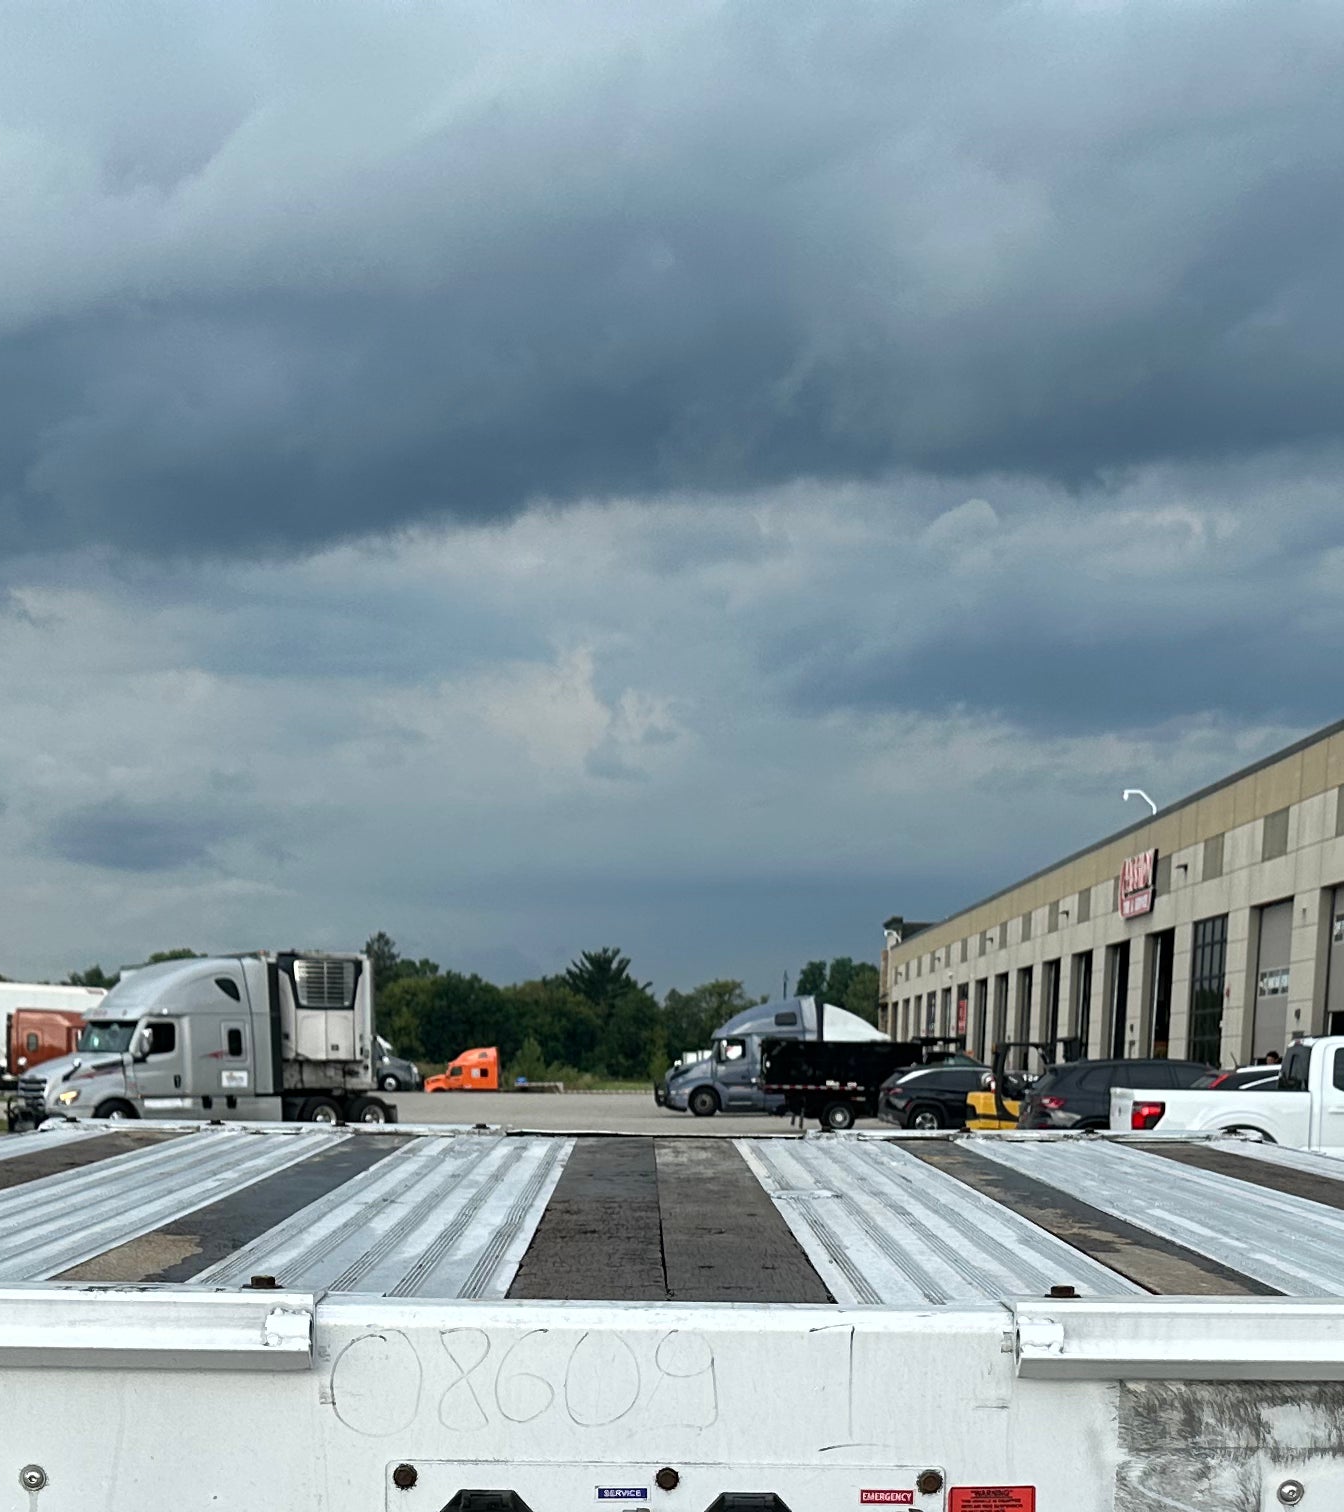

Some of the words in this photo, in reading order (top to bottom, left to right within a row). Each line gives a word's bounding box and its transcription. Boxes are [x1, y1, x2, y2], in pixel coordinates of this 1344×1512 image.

[330, 1327, 718, 1438] 08609
[603, 1489, 642, 1497] SERVICE
[862, 1492, 912, 1501] EMERGENCY
